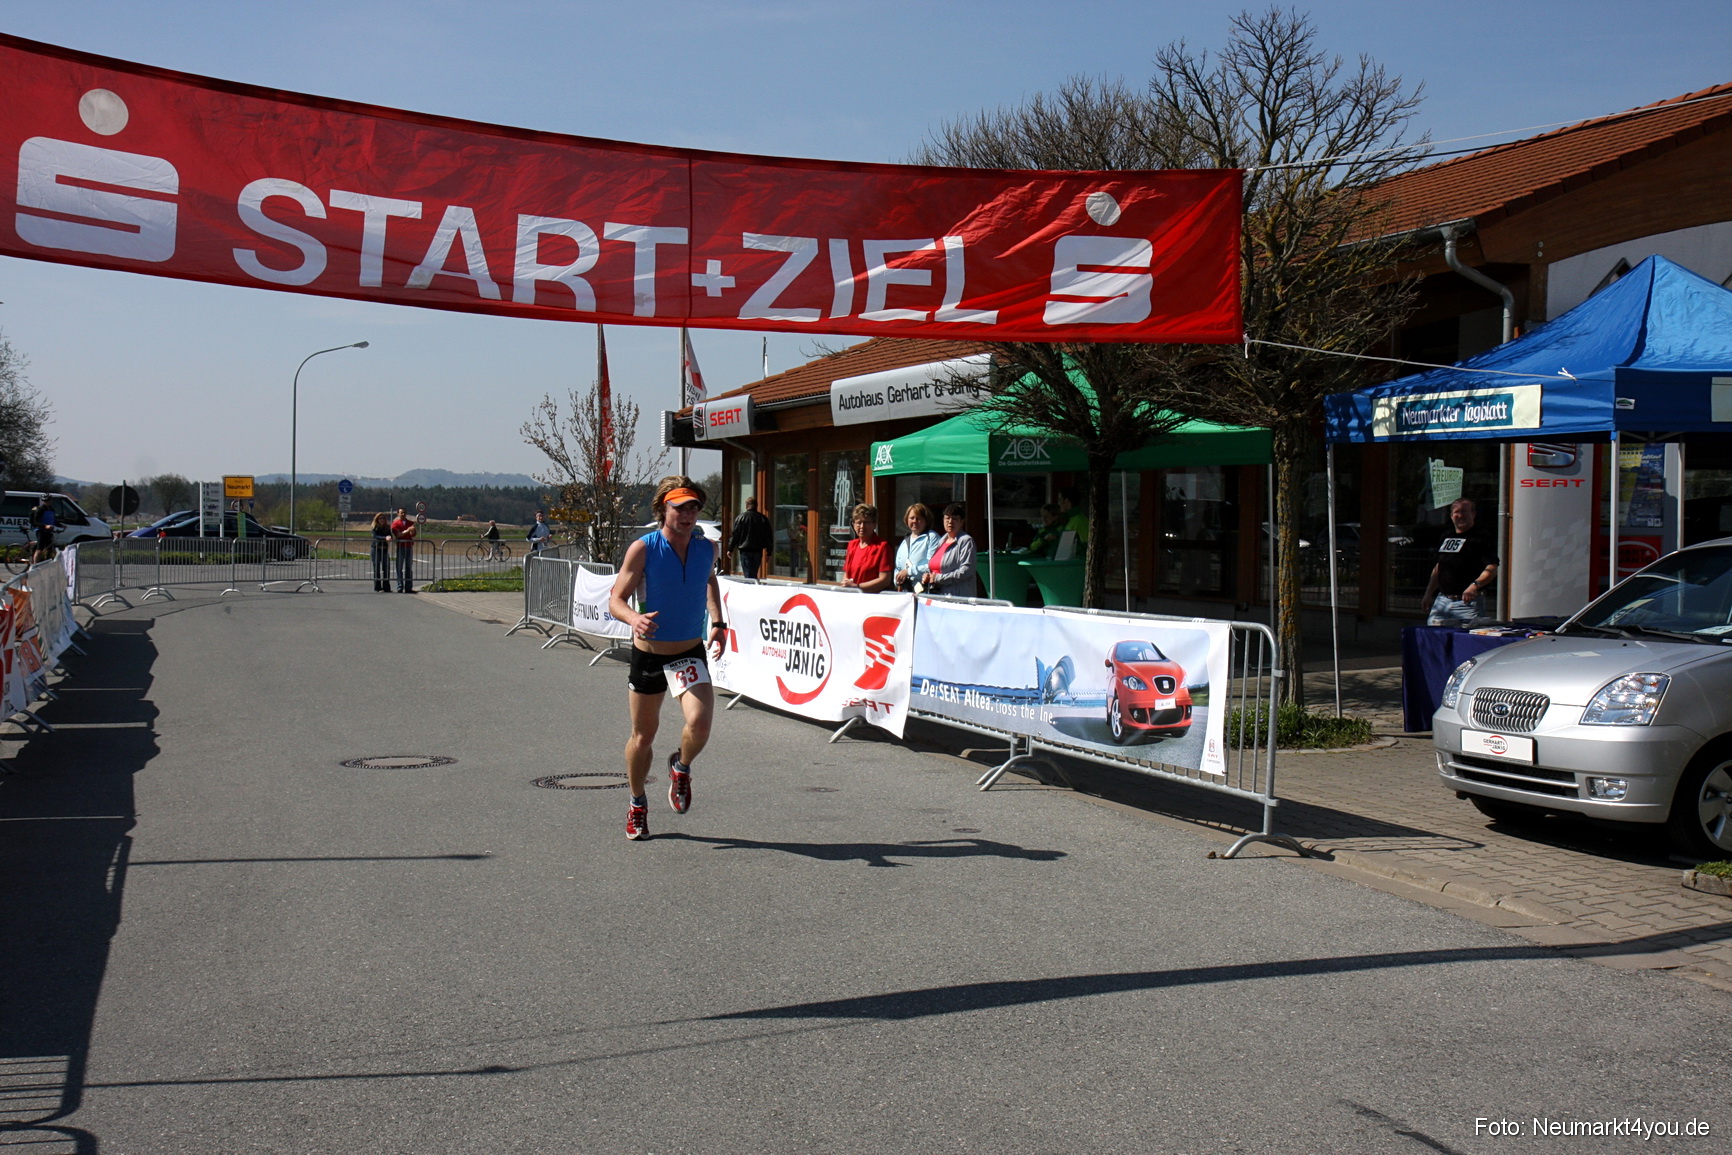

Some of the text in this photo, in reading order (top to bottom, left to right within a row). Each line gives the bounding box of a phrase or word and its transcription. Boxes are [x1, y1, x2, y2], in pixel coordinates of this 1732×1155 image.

[838, 390, 884, 411] Autohaus
[887, 383, 931, 404] Gerhart
[933, 378, 945, 398] &
[709, 408, 742, 427] SEAT
[1402, 401, 1508, 426] Neumarkter Tagblatt
[874, 443, 894, 466] AOK
[999, 438, 1051, 460] AOK
[1520, 478, 1586, 488] SEAT
[1443, 539, 1461, 551] 105
[759, 617, 817, 649] GERHART
[761, 645, 787, 659] AUTOHAUS
[785, 648, 825, 679] JÄNIG
[919, 678, 938, 697] Der
[938, 683, 960, 704] SEAT
[963, 688, 994, 712] Altea.
[1020, 704, 1035, 720] the
